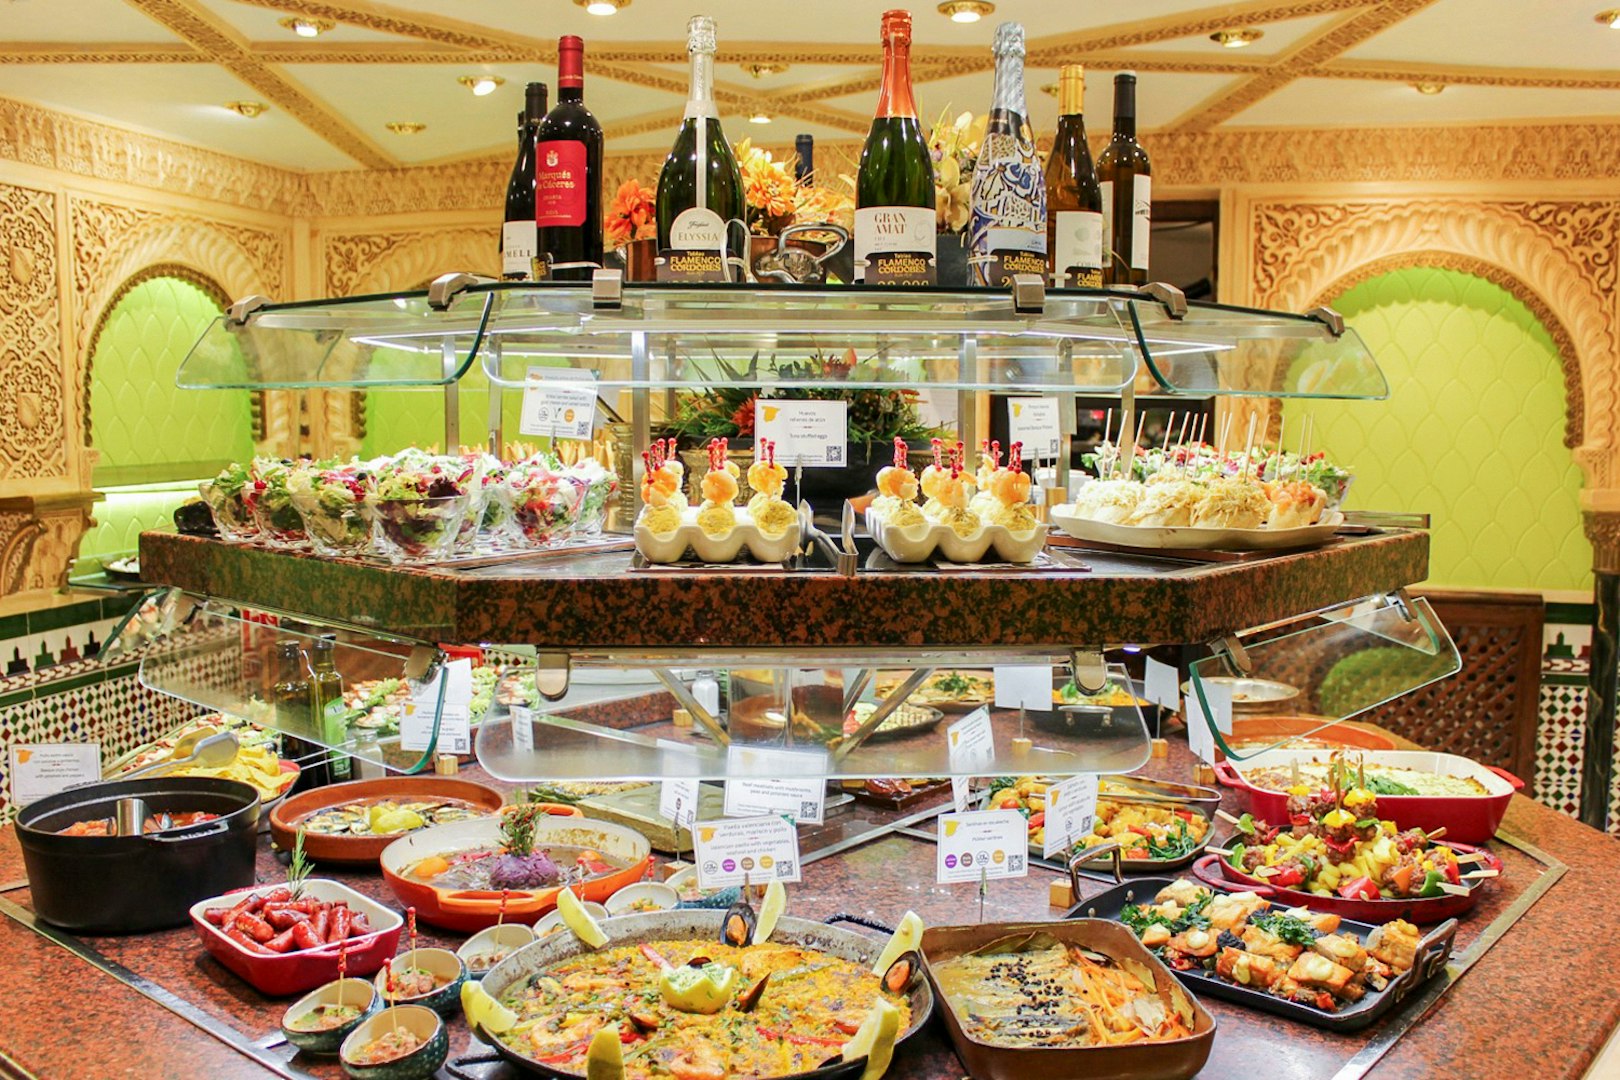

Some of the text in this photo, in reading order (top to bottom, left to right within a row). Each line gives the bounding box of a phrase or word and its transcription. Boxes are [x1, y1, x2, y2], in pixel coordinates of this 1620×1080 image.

[538, 170, 572, 180] Marqués
[543, 179, 575, 189] Cáceres
[874, 213, 906, 223] GRAN
[874, 224, 907, 234] AMAT
[678, 232, 719, 241] ELYSSIA
[670, 256, 721, 264] FLAMENCO
[878, 258, 926, 267] FLAMENCO
[1003, 255, 1044, 266] FLAMENCO
